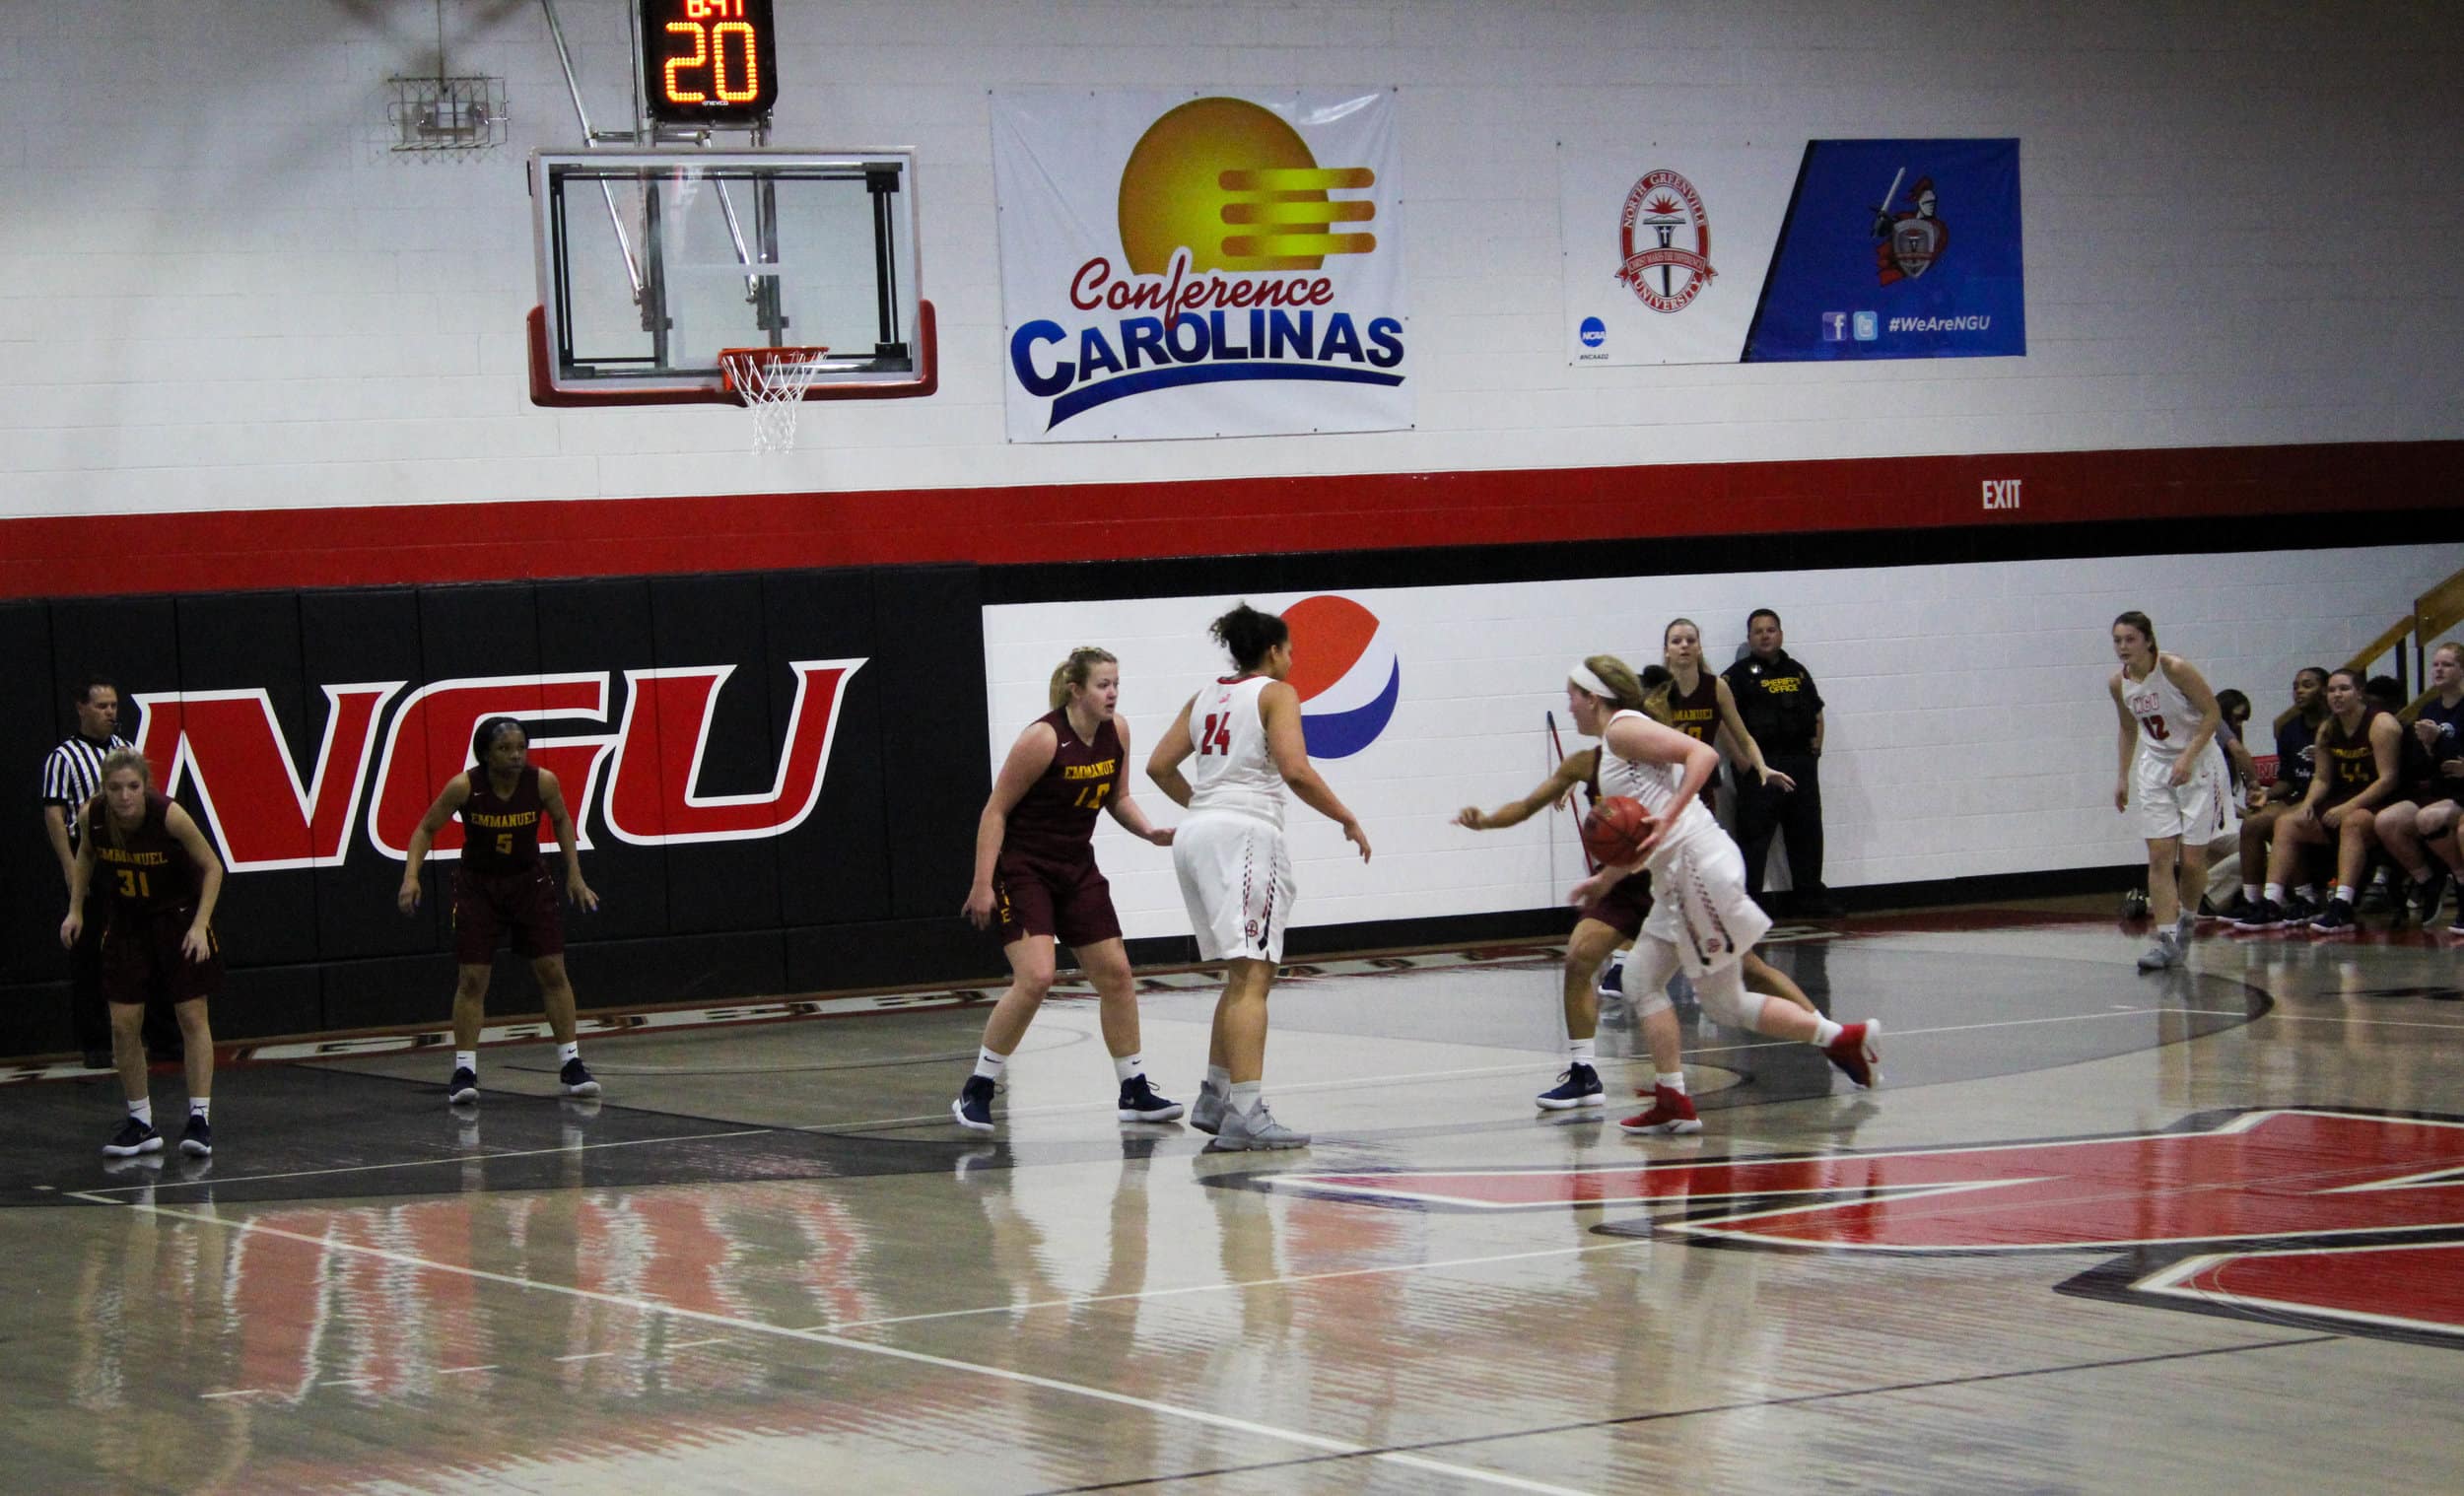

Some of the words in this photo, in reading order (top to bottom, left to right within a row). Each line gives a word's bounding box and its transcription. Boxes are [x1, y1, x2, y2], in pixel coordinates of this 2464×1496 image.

[665, 22, 758, 101] 20
[1624, 181, 1647, 228] NORTH
[1650, 171, 1705, 226] GREENVILLE
[1070, 254, 1335, 330] Conference
[1633, 277, 1702, 311] UNIVERSITY
[1888, 315, 1991, 333] #WeAreNGU
[1010, 308, 1405, 398] CAROLINAS
[1982, 479, 2021, 510] EXIT
[1201, 712, 1230, 756] 24
[2142, 714, 2170, 741] 12
[132, 657, 870, 872] NGU
[1064, 758, 1116, 780] EMMANUE
[471, 811, 536, 828] EMMANUEL
[496, 833, 513, 855] 5
[116, 868, 150, 898] 31
